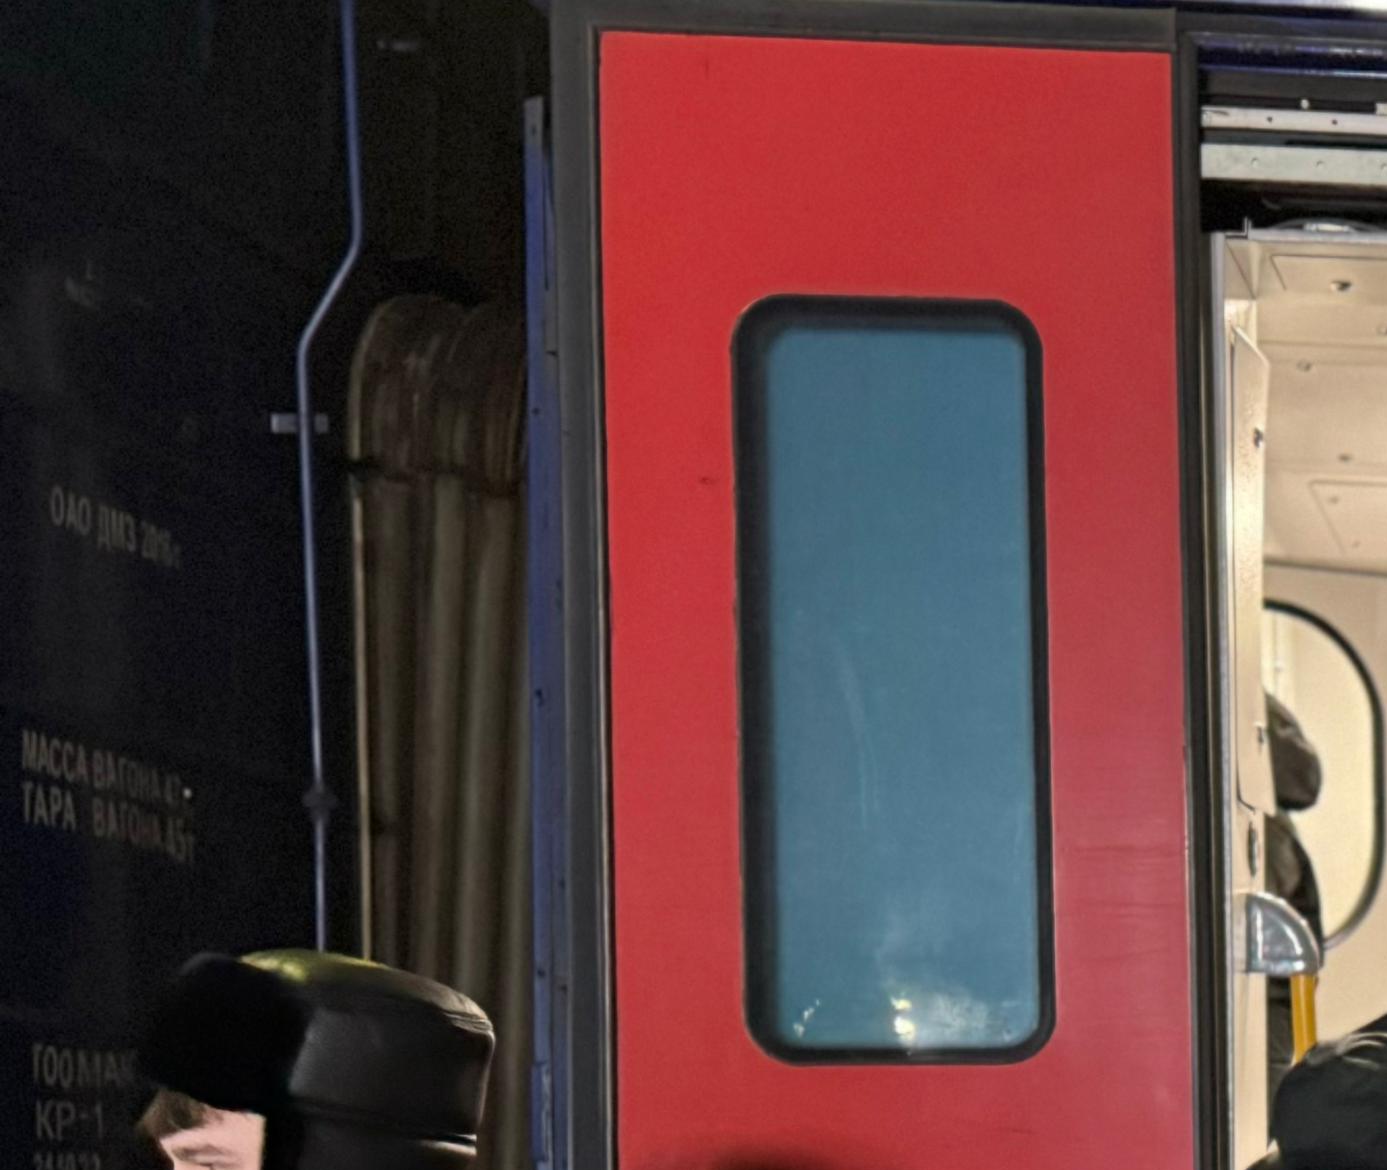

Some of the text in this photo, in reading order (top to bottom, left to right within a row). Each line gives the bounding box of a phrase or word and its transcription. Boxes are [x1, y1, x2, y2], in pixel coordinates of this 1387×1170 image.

[22, 728, 89, 783] МАССА
[21, 779, 77, 832] ТАРА
[34, 1098, 103, 1142] КР-1
